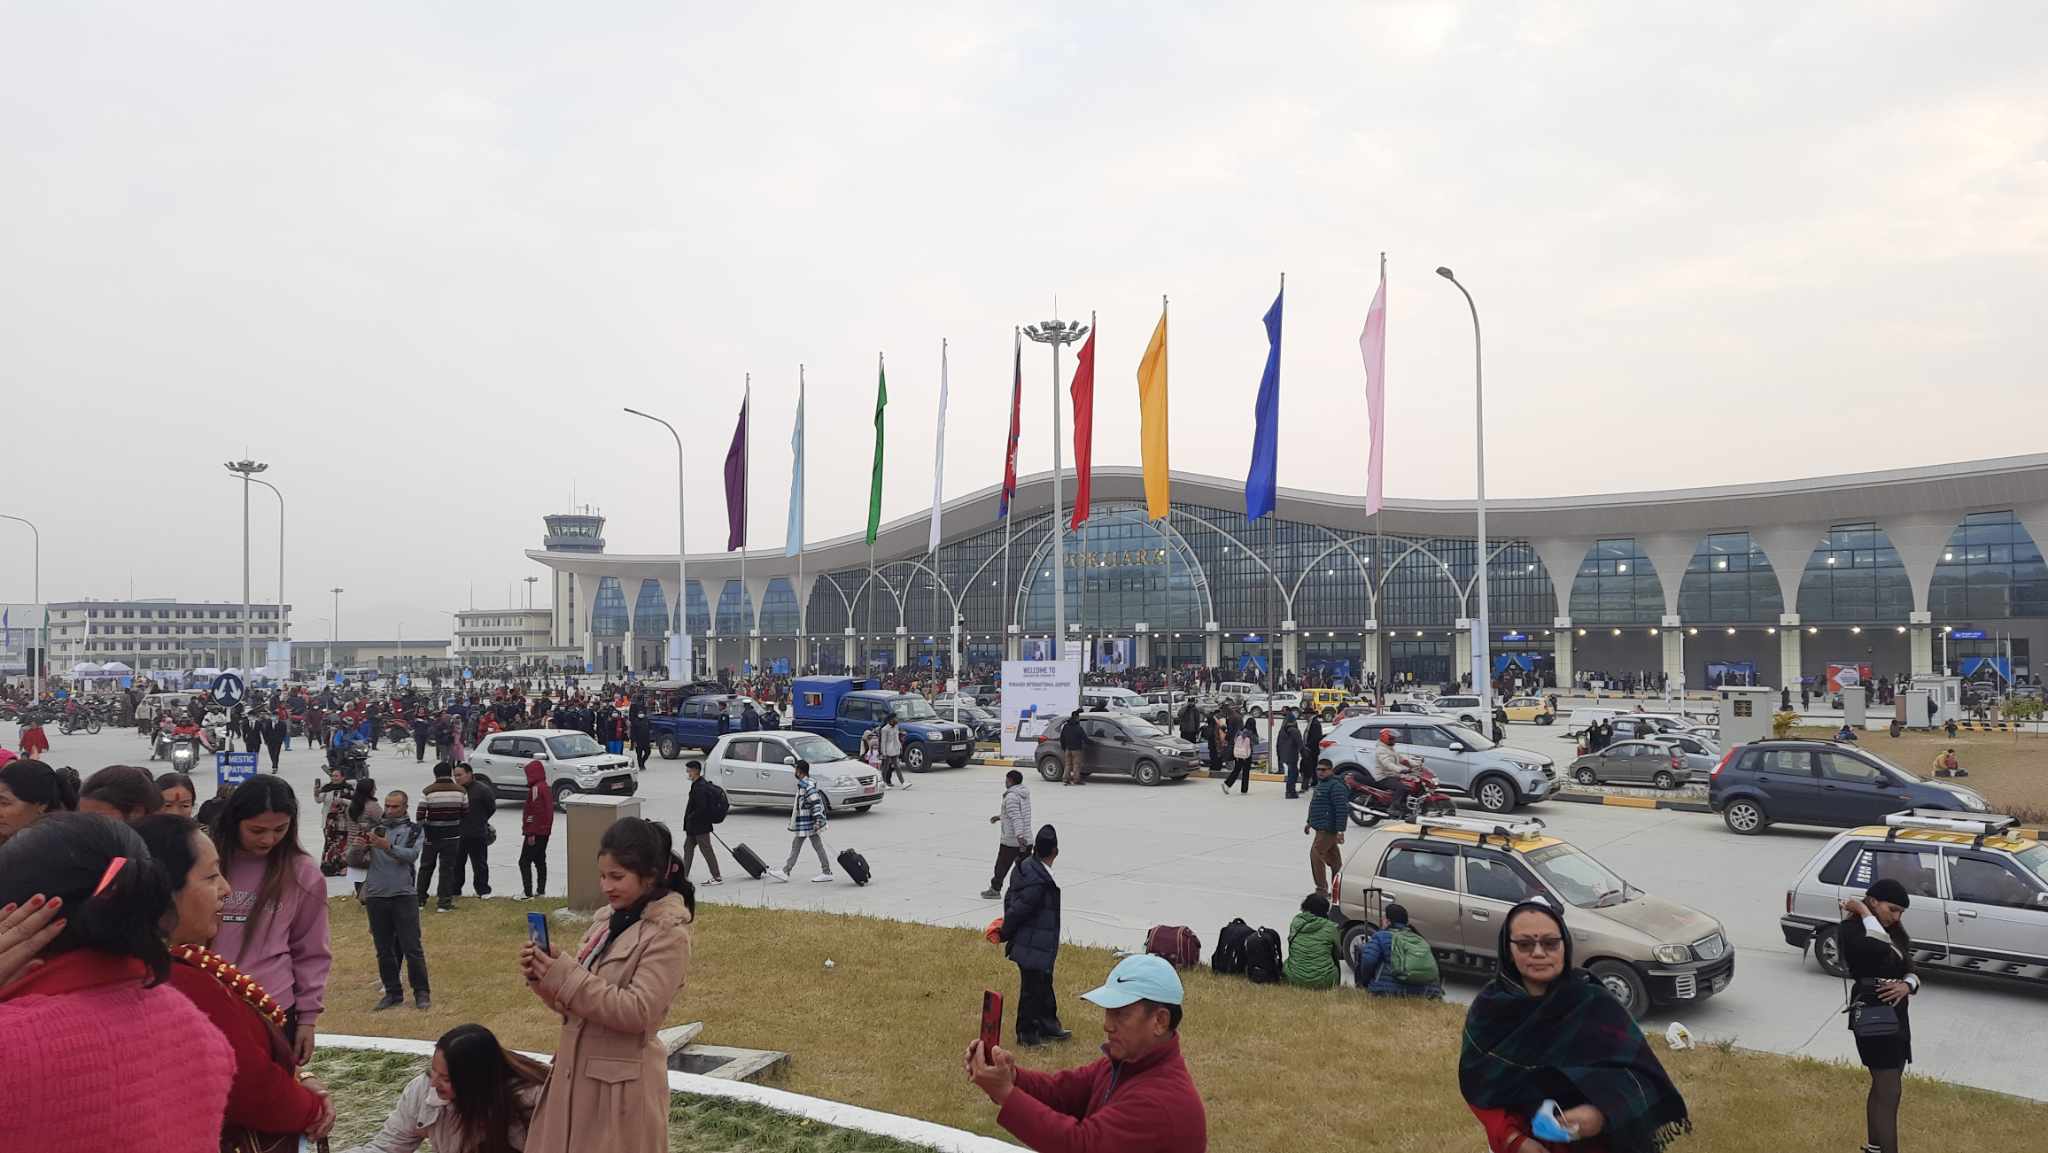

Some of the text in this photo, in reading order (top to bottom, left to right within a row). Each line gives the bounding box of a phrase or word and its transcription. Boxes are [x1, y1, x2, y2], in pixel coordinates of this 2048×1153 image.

[1023, 666, 1056, 674] WELCOME TO
[219, 755, 254, 763] DMESTIC
